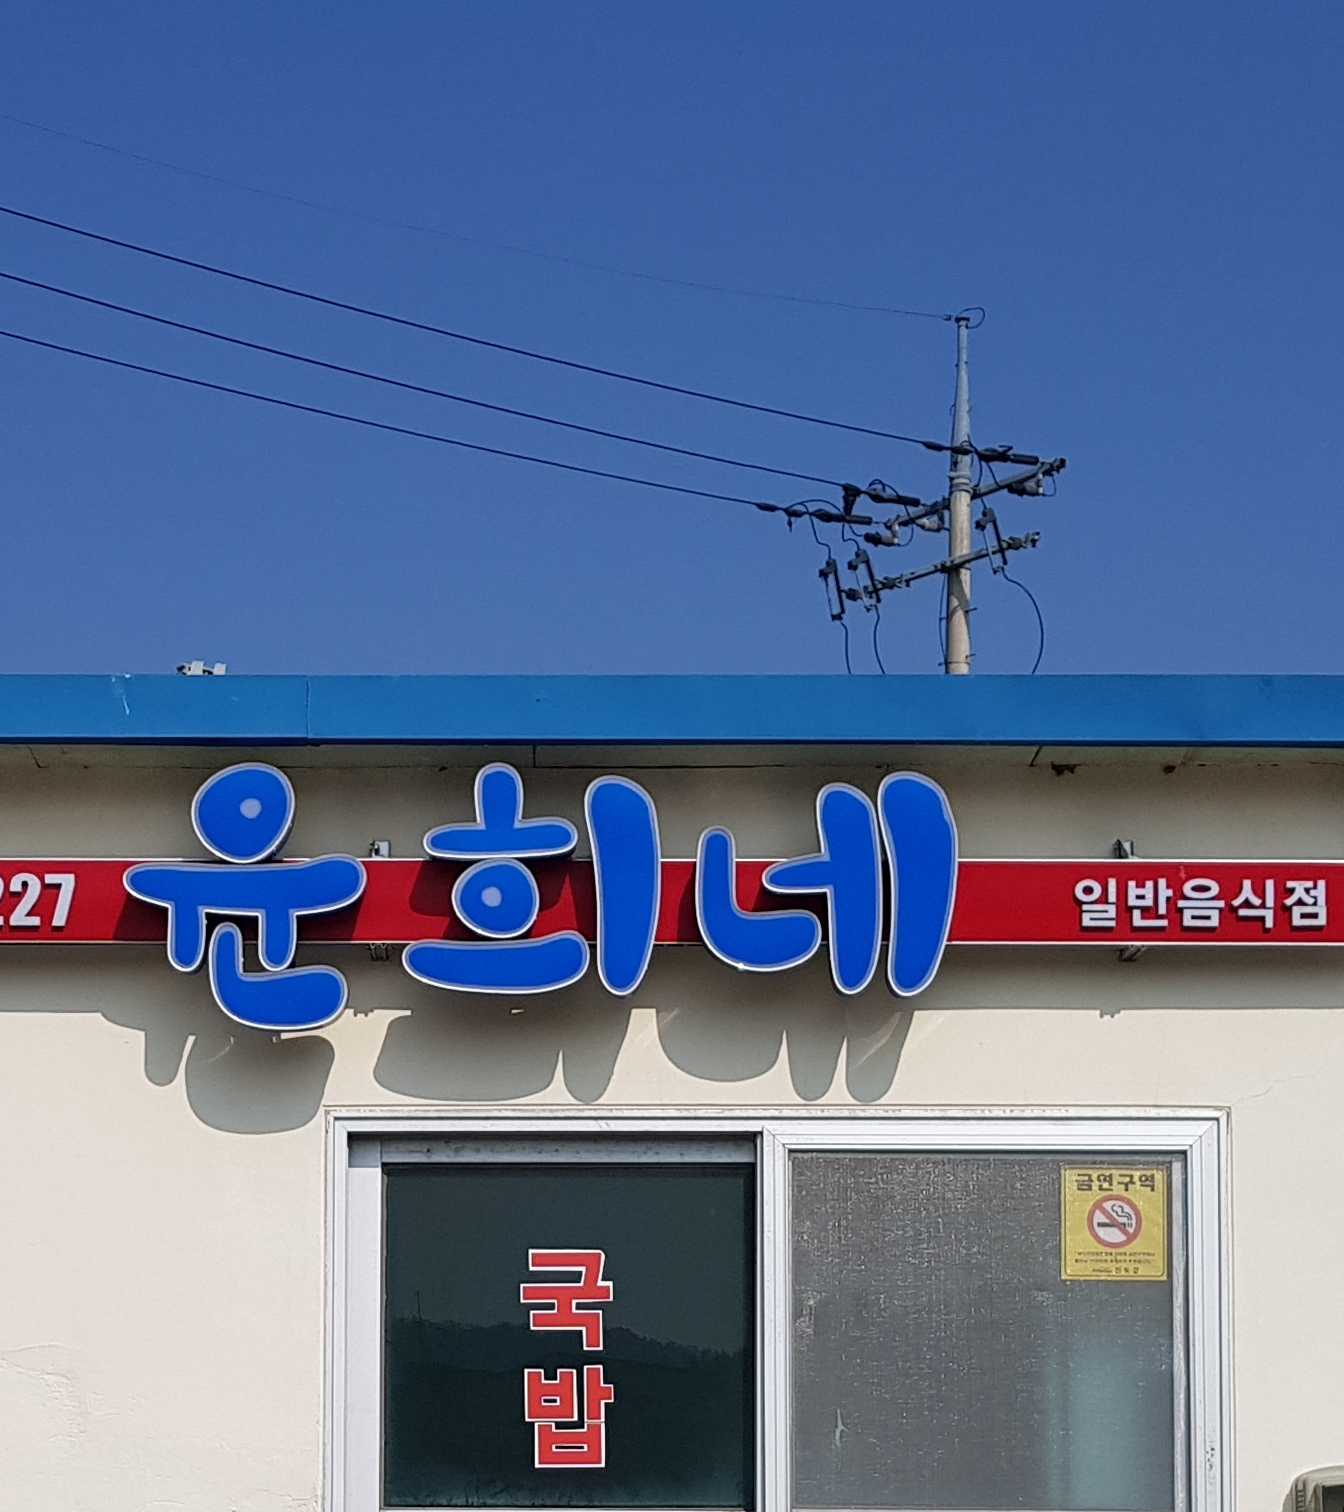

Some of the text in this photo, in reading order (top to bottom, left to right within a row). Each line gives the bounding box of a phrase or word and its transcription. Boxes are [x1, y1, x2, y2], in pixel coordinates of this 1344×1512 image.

[122, 761, 959, 1030] 윤희네
[1073, 877, 1330, 929] 일반음식점
[1074, 1172, 1156, 1192] 금연구역
[519, 1248, 615, 1468] 국밥
